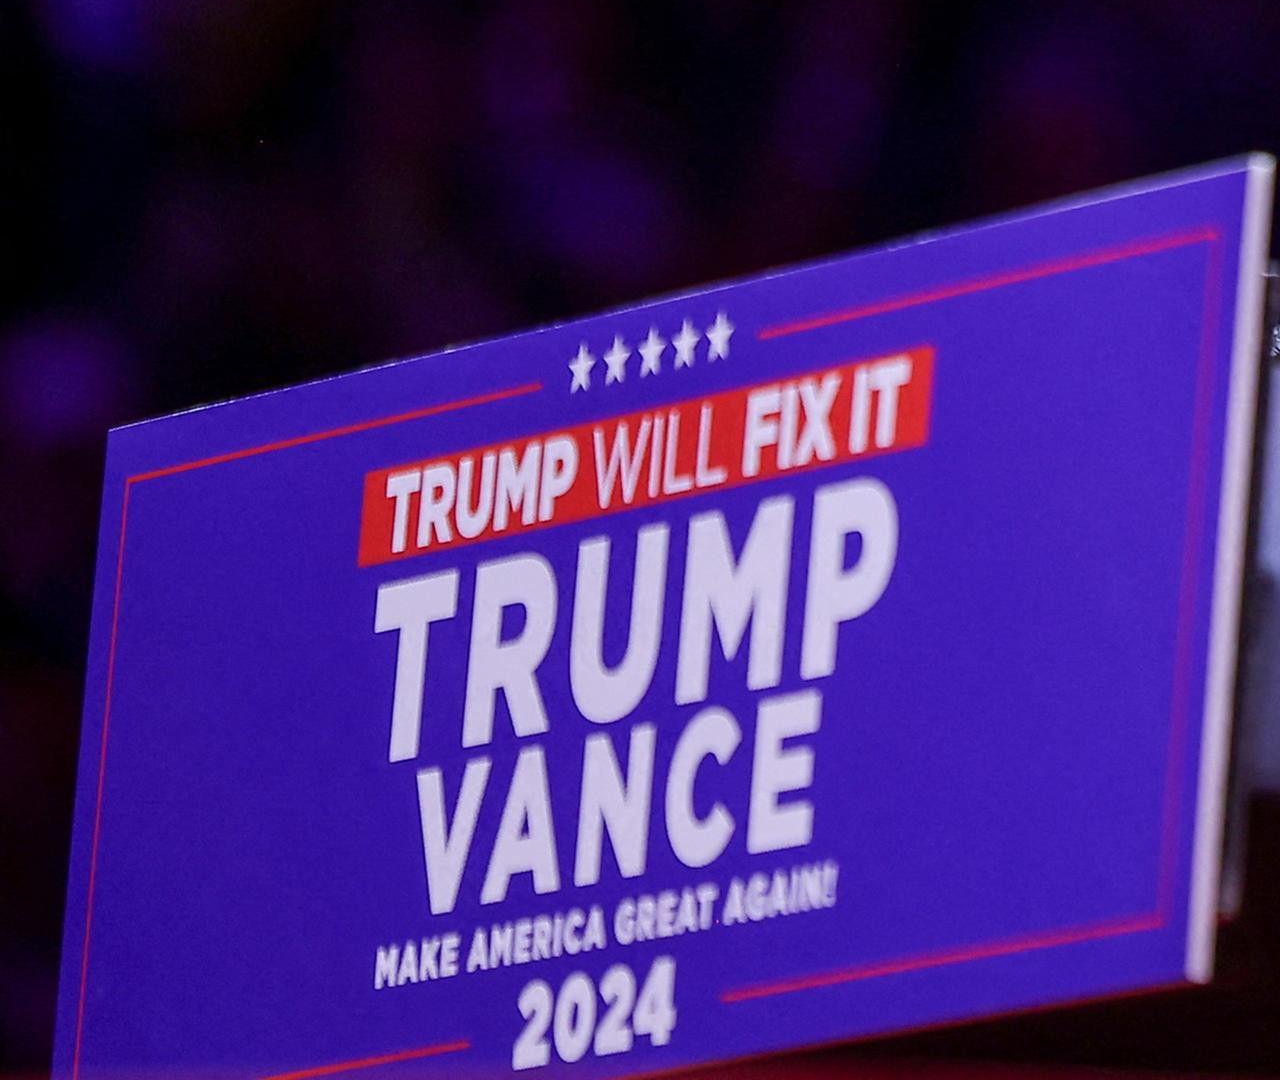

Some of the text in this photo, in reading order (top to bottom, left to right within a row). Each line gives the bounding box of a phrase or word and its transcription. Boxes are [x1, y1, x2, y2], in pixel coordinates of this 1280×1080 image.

[385, 354, 912, 554] TRUMP WILL FIX IT
[373, 477, 899, 763] TRUMP
[416, 687, 823, 916] VANCE
[373, 859, 840, 990] MAKE AMERICA GREAT AGAIN!
[511, 955, 677, 1072] 2024
